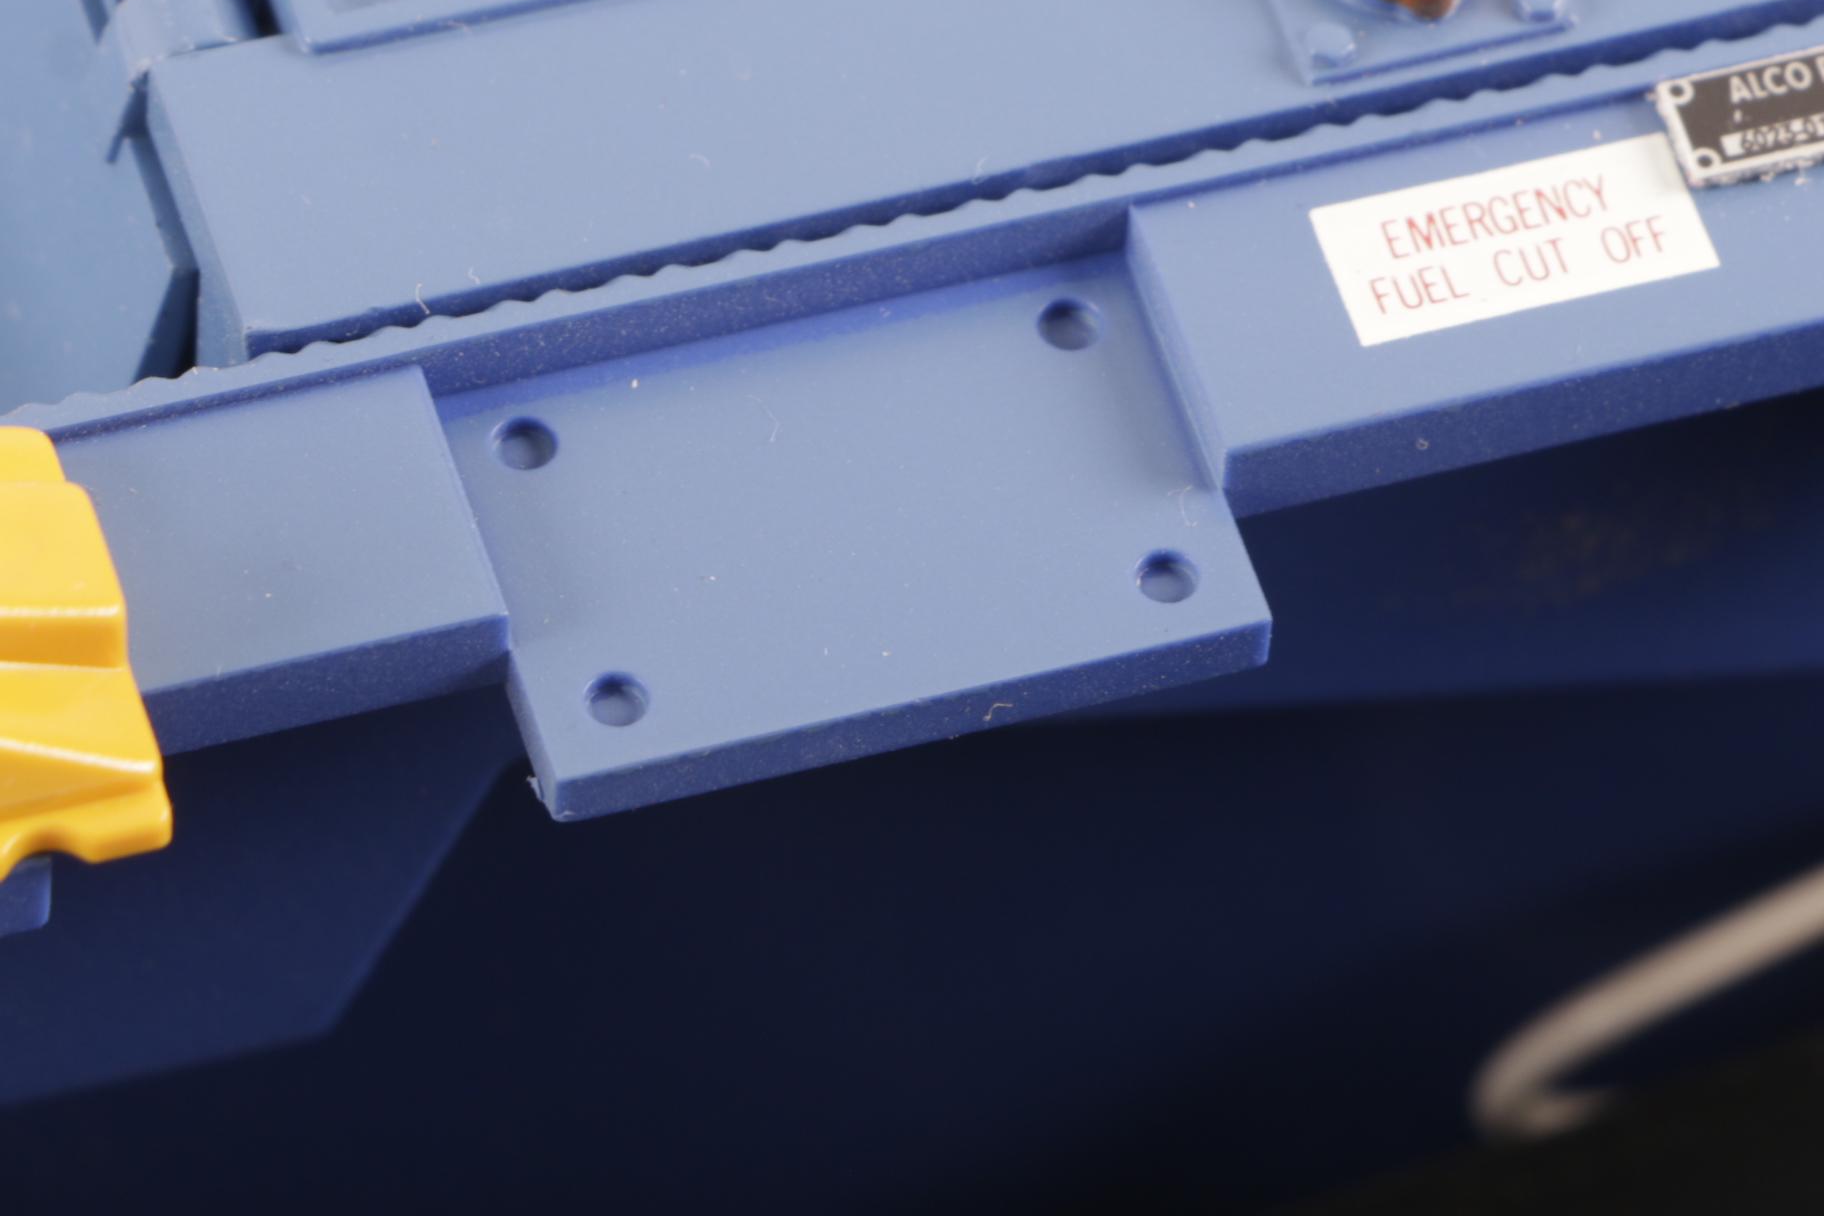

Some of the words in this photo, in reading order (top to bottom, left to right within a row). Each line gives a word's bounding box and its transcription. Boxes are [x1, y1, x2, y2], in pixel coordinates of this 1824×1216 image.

[1728, 60, 1812, 104] ALCO
[1382, 175, 1607, 260] EMERGENCY
[1370, 266, 1470, 314] FUEL
[1492, 238, 1569, 287] CUT
[1600, 215, 1666, 264] OFF
